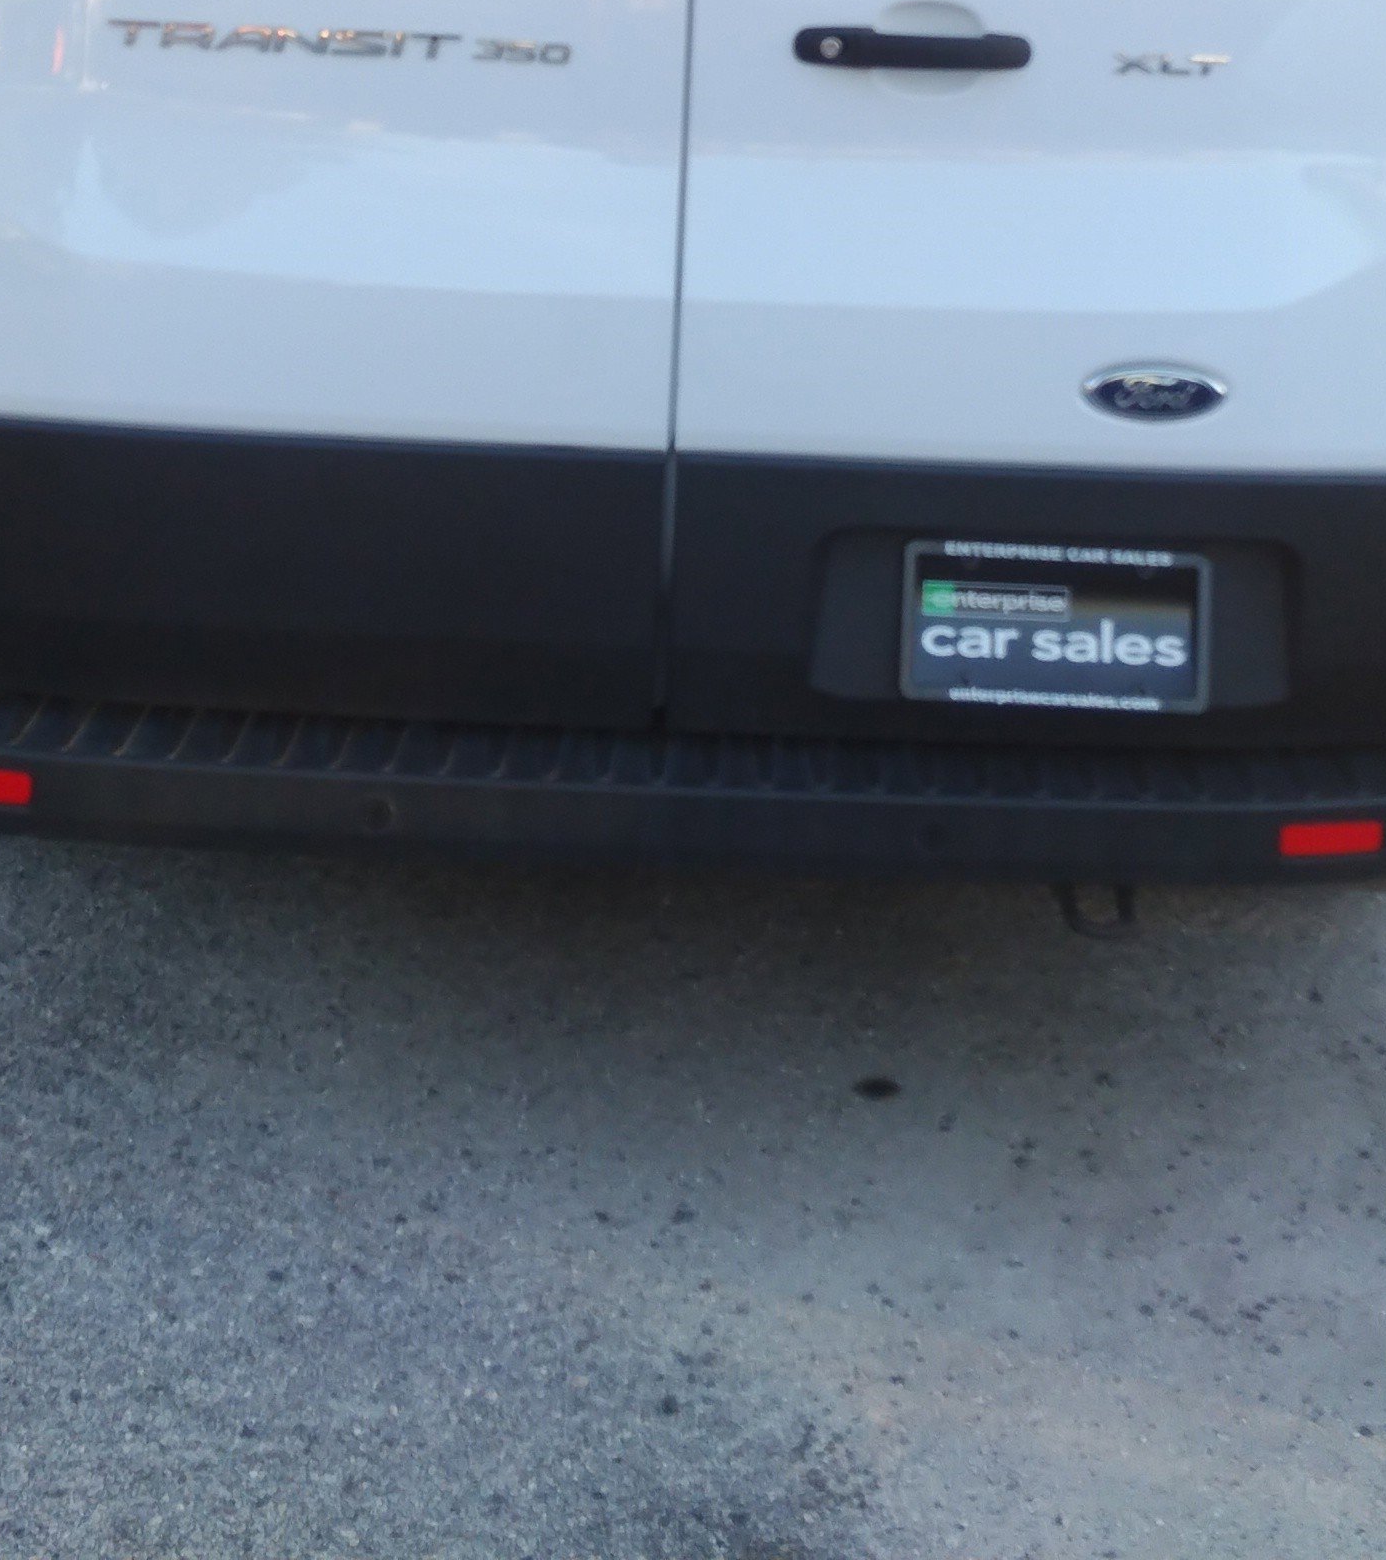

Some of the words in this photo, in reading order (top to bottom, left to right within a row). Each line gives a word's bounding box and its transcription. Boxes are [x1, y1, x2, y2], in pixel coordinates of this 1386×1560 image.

[108, 19, 463, 60] TRANSIT
[472, 40, 572, 67] 350
[1113, 53, 1232, 77] XLT
[927, 590, 1067, 614] enterprise
[921, 624, 1021, 659] car
[1030, 616, 1187, 668] sales
